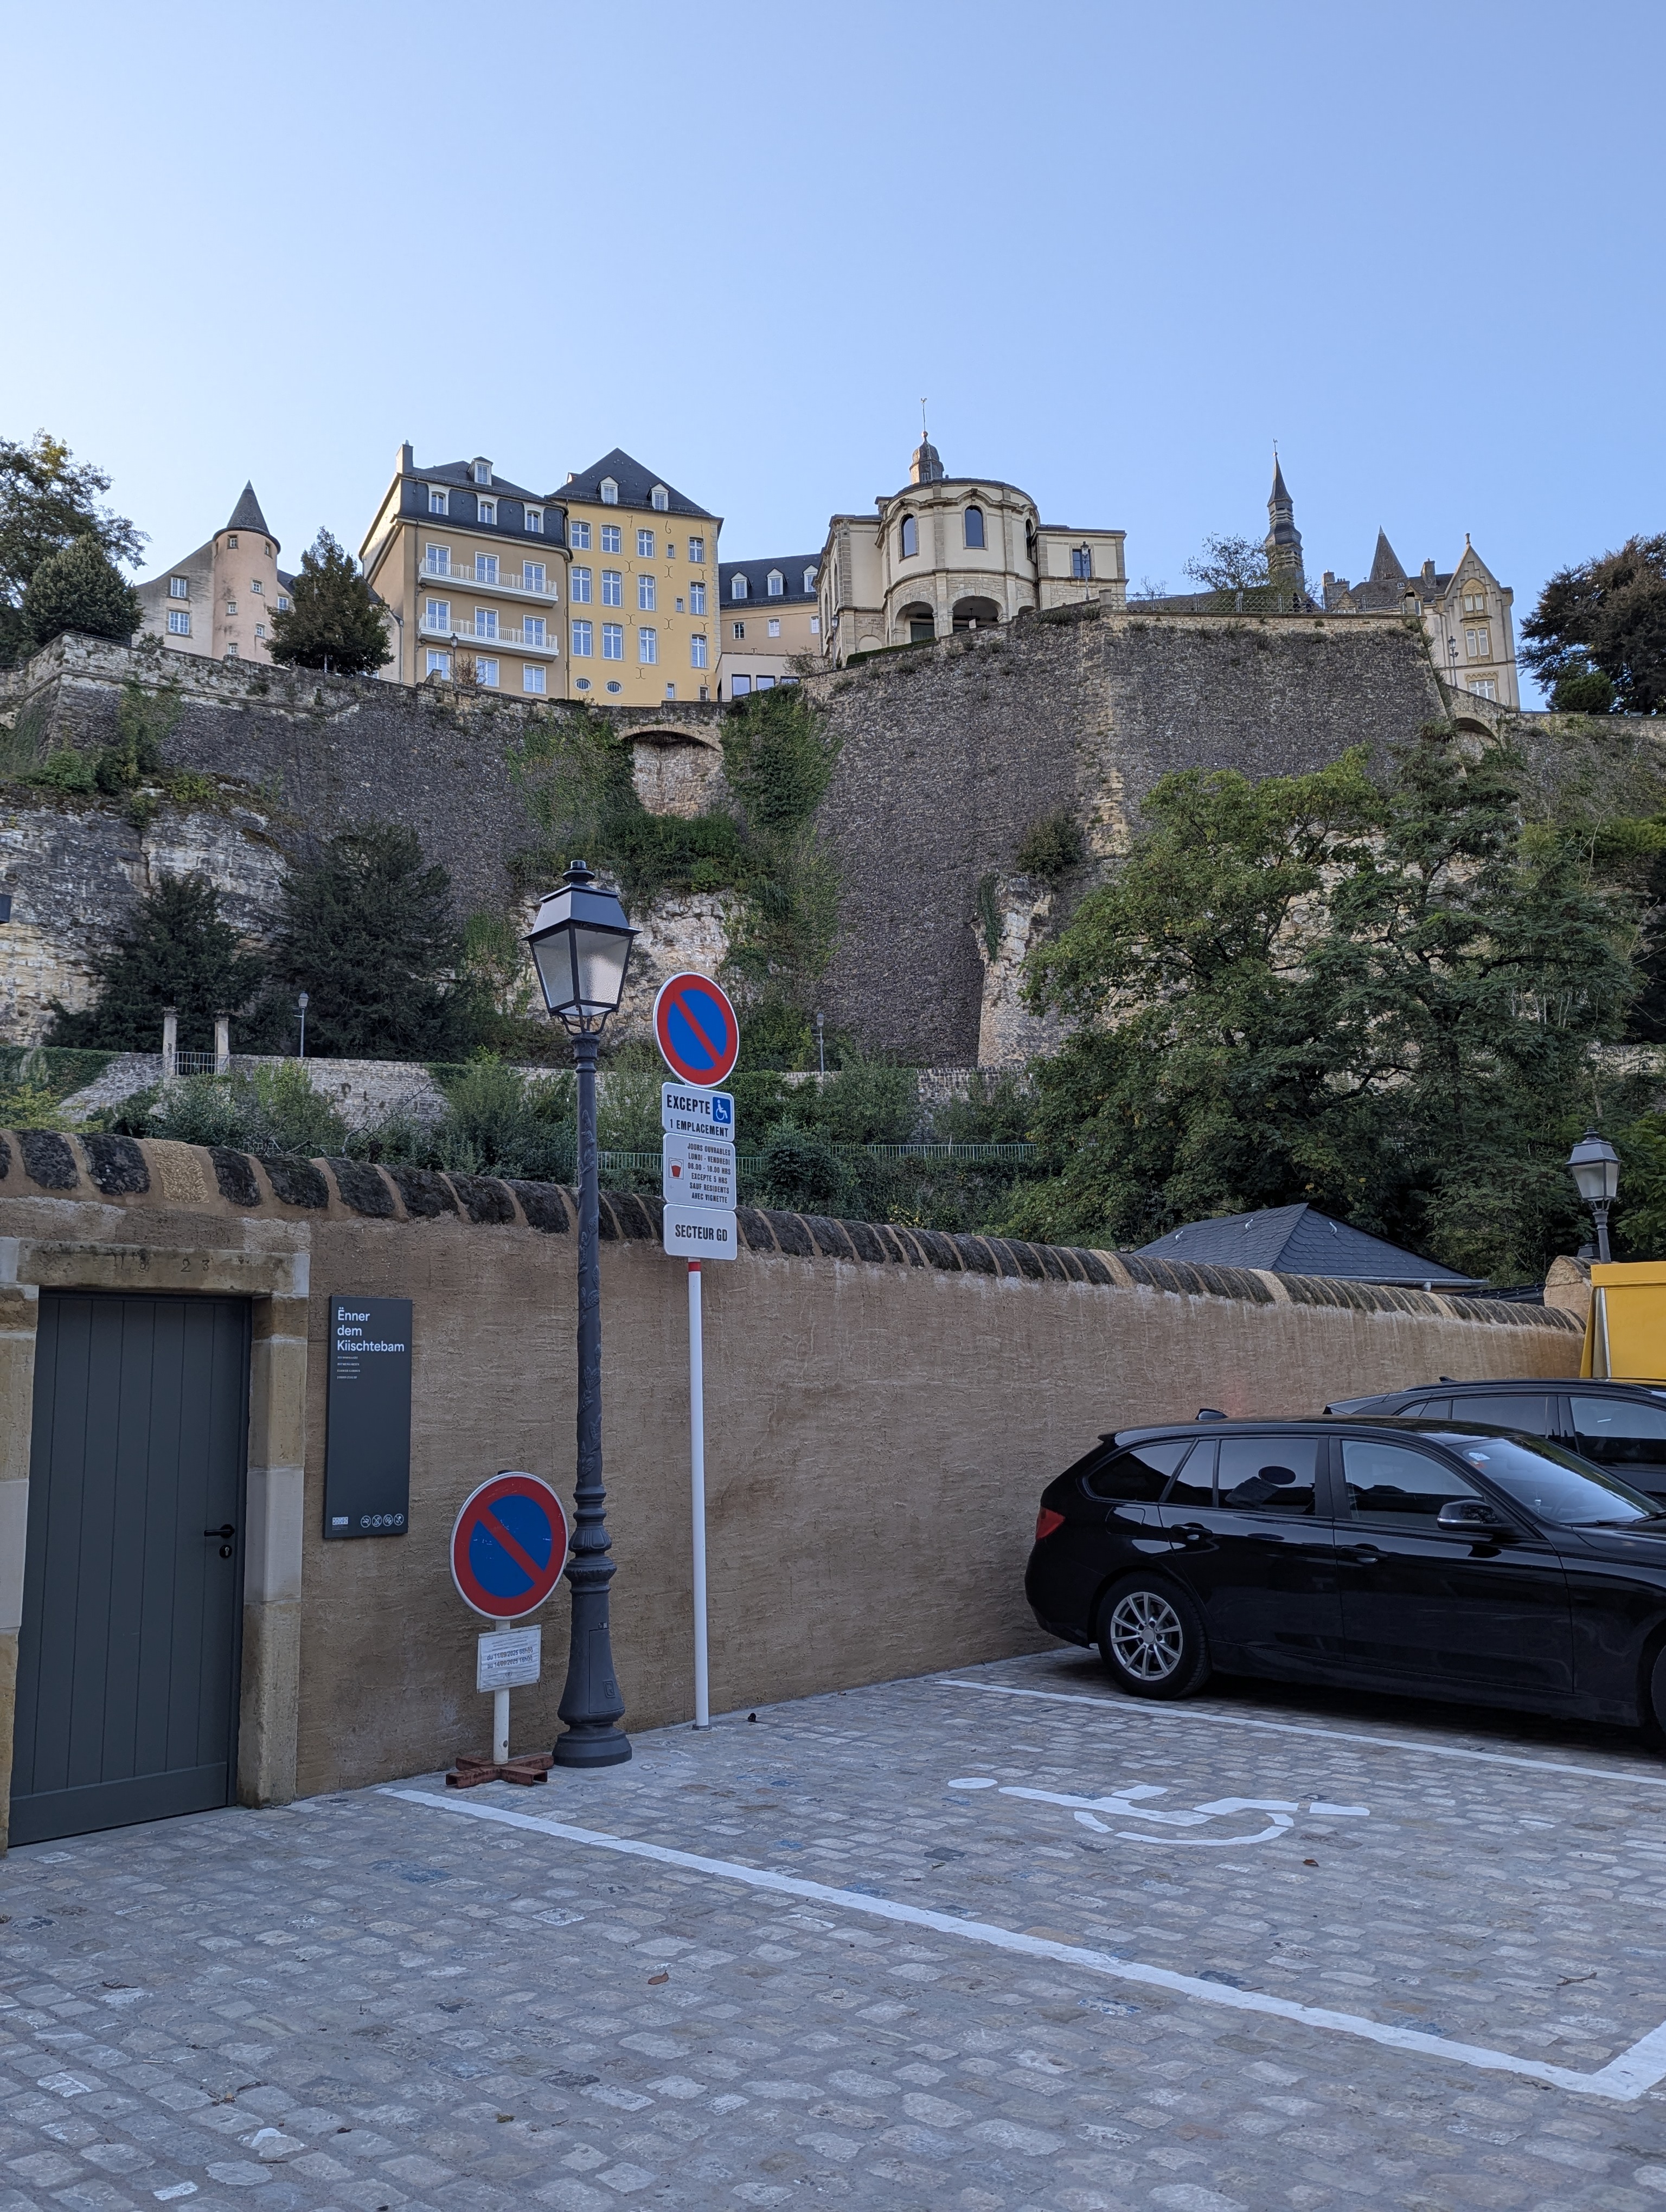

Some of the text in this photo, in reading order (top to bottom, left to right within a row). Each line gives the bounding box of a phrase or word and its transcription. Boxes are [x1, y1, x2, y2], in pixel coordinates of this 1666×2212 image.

[667, 1094, 711, 1115] EXCEPTE
[670, 1118, 728, 1137] 1 EMPLACEMENT
[687, 1142, 731, 1156] JOURS OUVRABLES
[688, 1152, 702, 1161] LUNDI
[708, 1156, 730, 1165] VENDREDI
[688, 1162, 702, 1171] 08.00
[707, 1165, 720, 1173] 18.00
[691, 1173, 712, 1182] EXCEPTE
[689, 1182, 729, 1194] SAUF RESIDENTS
[705, 1194, 728, 1203] VIGNETTE
[675, 1224, 727, 1242] SECTEUR GD
[337, 1307, 371, 1322] Ënner
[337, 1324, 362, 1336] dem
[337, 1340, 405, 1352] Kiischtebam
